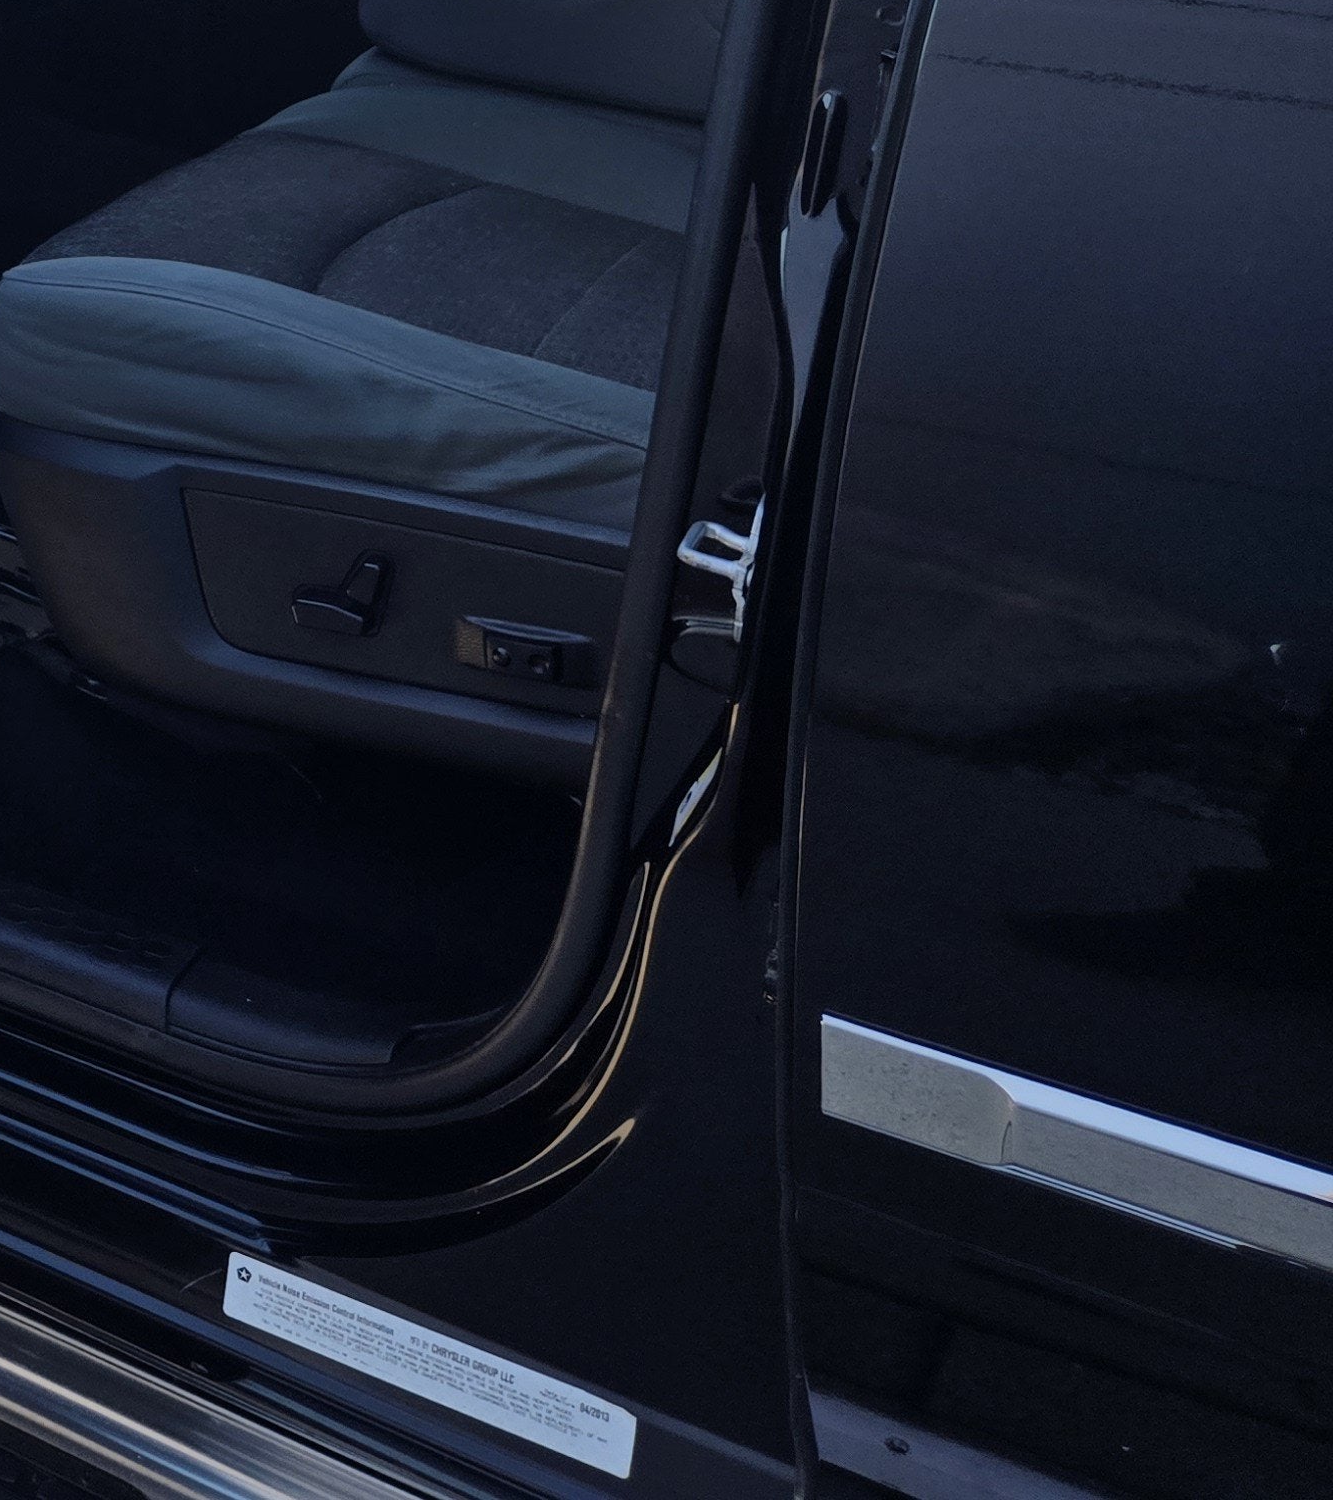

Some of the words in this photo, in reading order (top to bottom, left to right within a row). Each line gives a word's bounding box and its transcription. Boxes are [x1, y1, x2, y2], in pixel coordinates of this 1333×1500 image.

[331, 1304, 355, 1320] Control
[431, 1344, 470, 1366] CHRYSLER
[472, 1360, 498, 1377] GROUP
[500, 1371, 515, 1385] LLC
[579, 1403, 610, 1422] 04/2013
